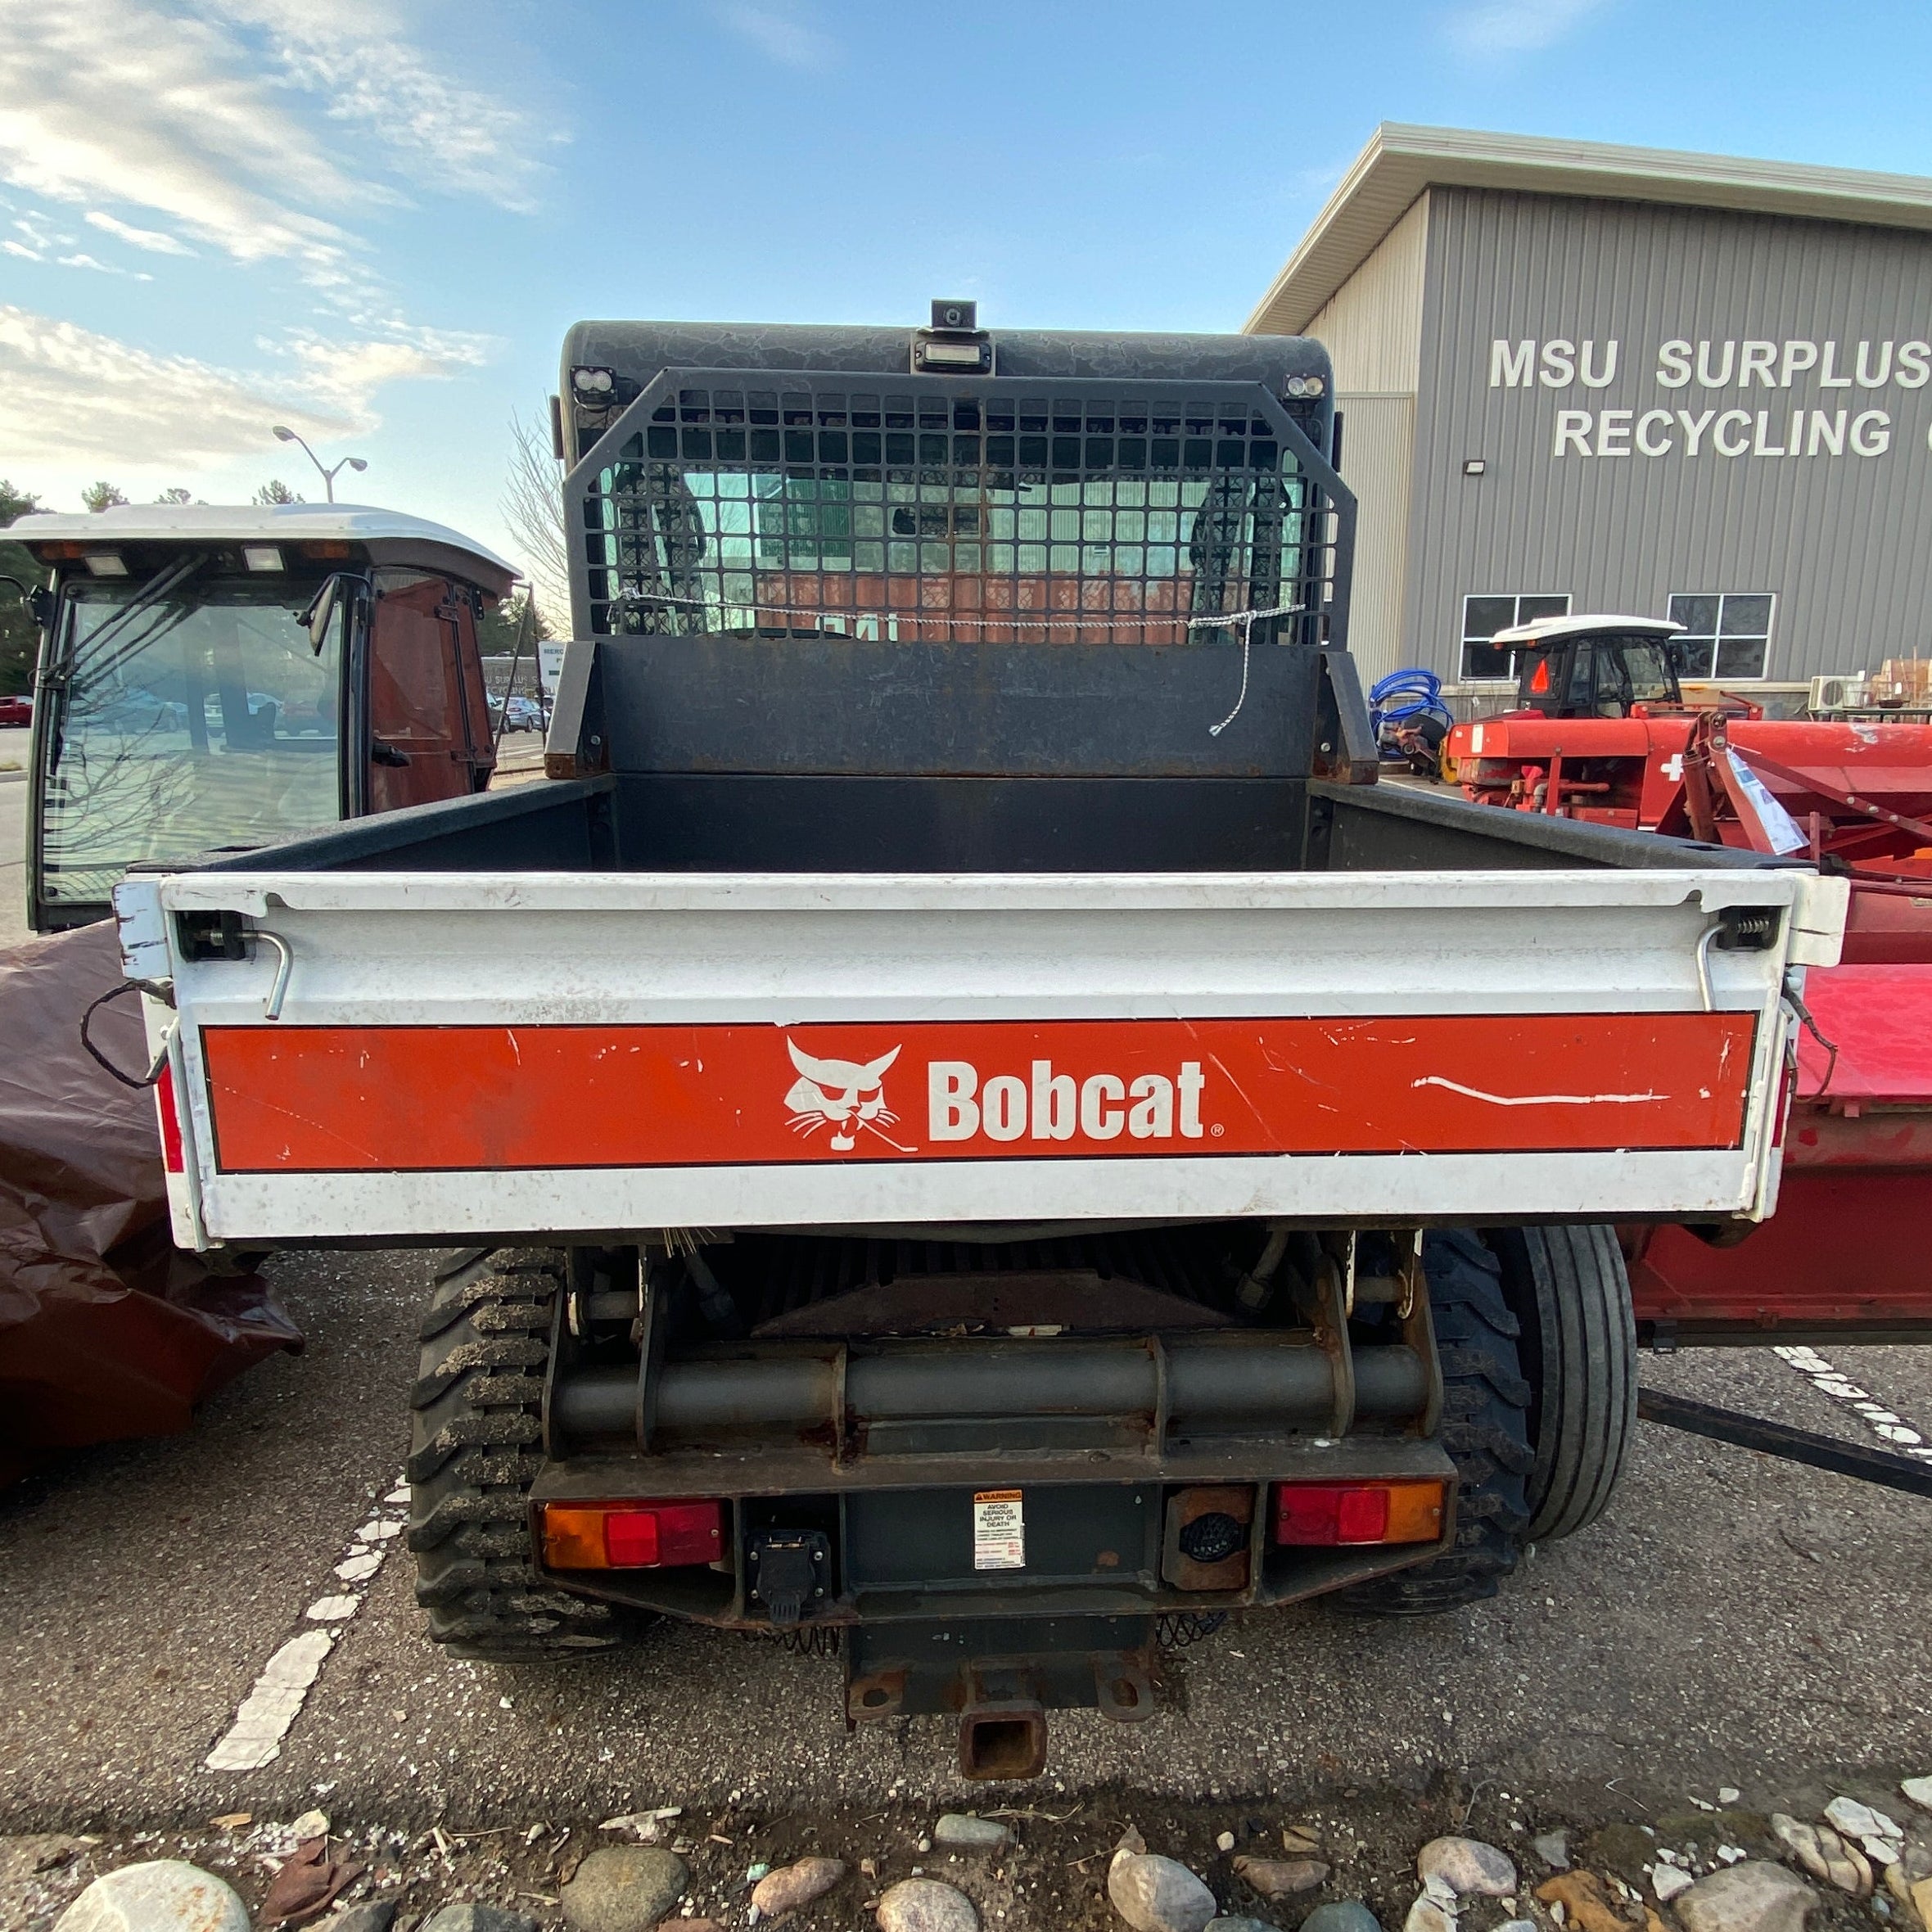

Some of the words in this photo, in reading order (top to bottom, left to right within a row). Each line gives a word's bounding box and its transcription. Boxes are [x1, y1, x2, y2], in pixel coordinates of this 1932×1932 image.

[1490, 339, 1618, 389] MSU
[1655, 340, 1932, 390] SURPLUS
[1554, 409, 1891, 458] RECYCLING
[928, 1059, 1205, 1142] Bobcat
[982, 1492, 1022, 1500] WARNING
